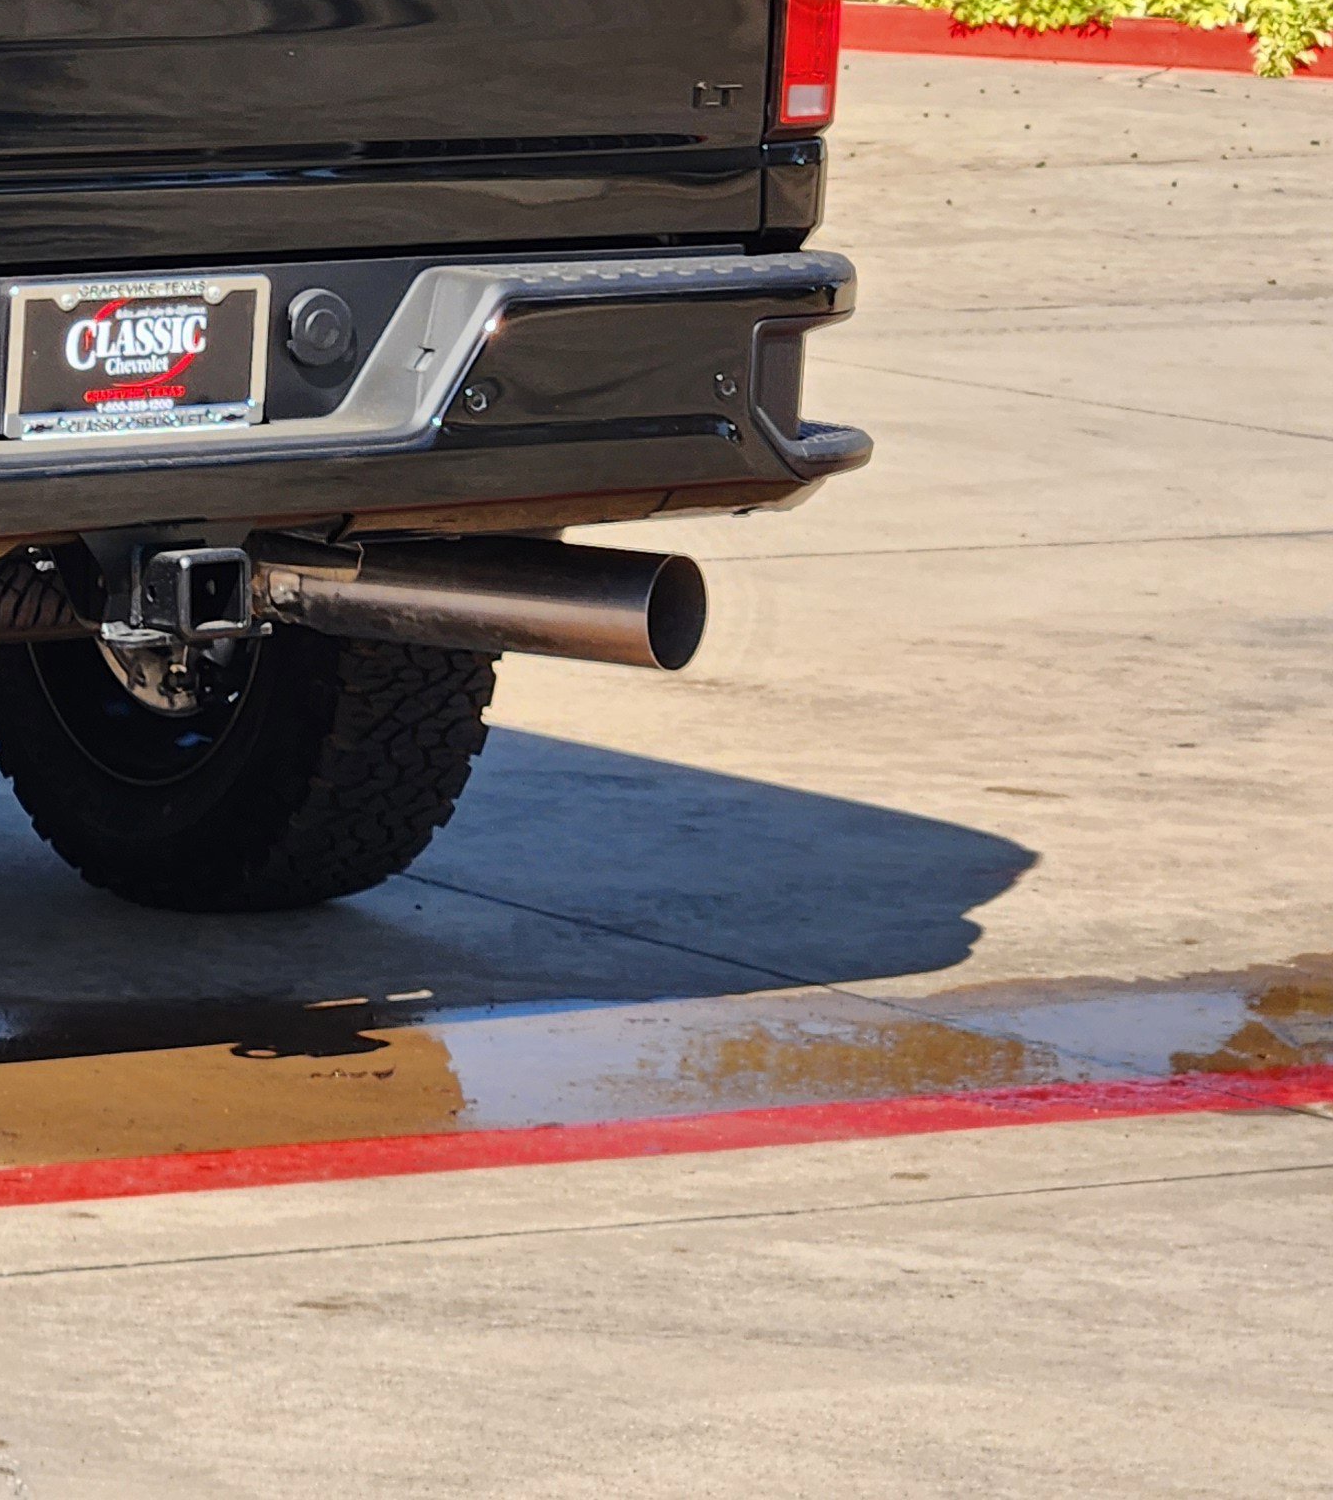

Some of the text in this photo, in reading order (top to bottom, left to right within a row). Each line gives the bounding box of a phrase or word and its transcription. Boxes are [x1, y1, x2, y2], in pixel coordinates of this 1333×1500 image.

[692, 81, 744, 109] LT
[164, 280, 207, 294] TEXAS
[65, 314, 208, 371] CLASSIC
[105, 353, 170, 376] Chevrolet
